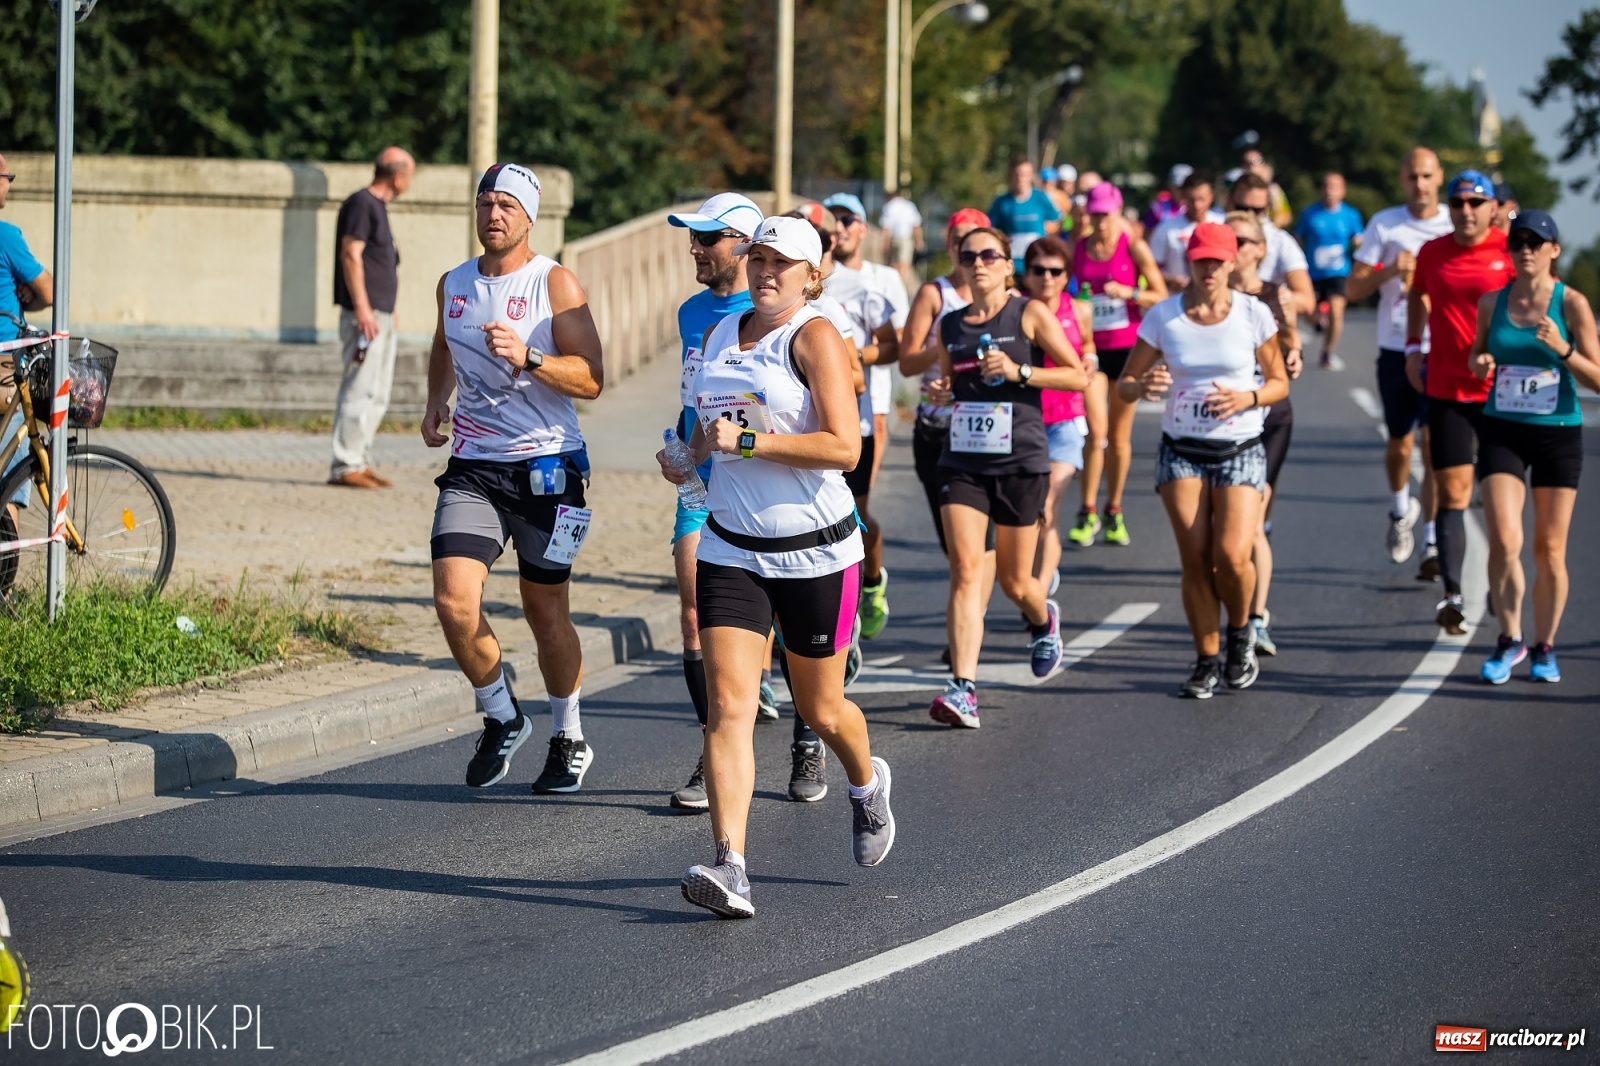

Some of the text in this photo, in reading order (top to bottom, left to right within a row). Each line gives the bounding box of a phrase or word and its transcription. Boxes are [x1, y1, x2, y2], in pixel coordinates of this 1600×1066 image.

[1521, 379, 1537, 395] 18
[721, 409, 749, 429] 75
[968, 416, 994, 432] 129
